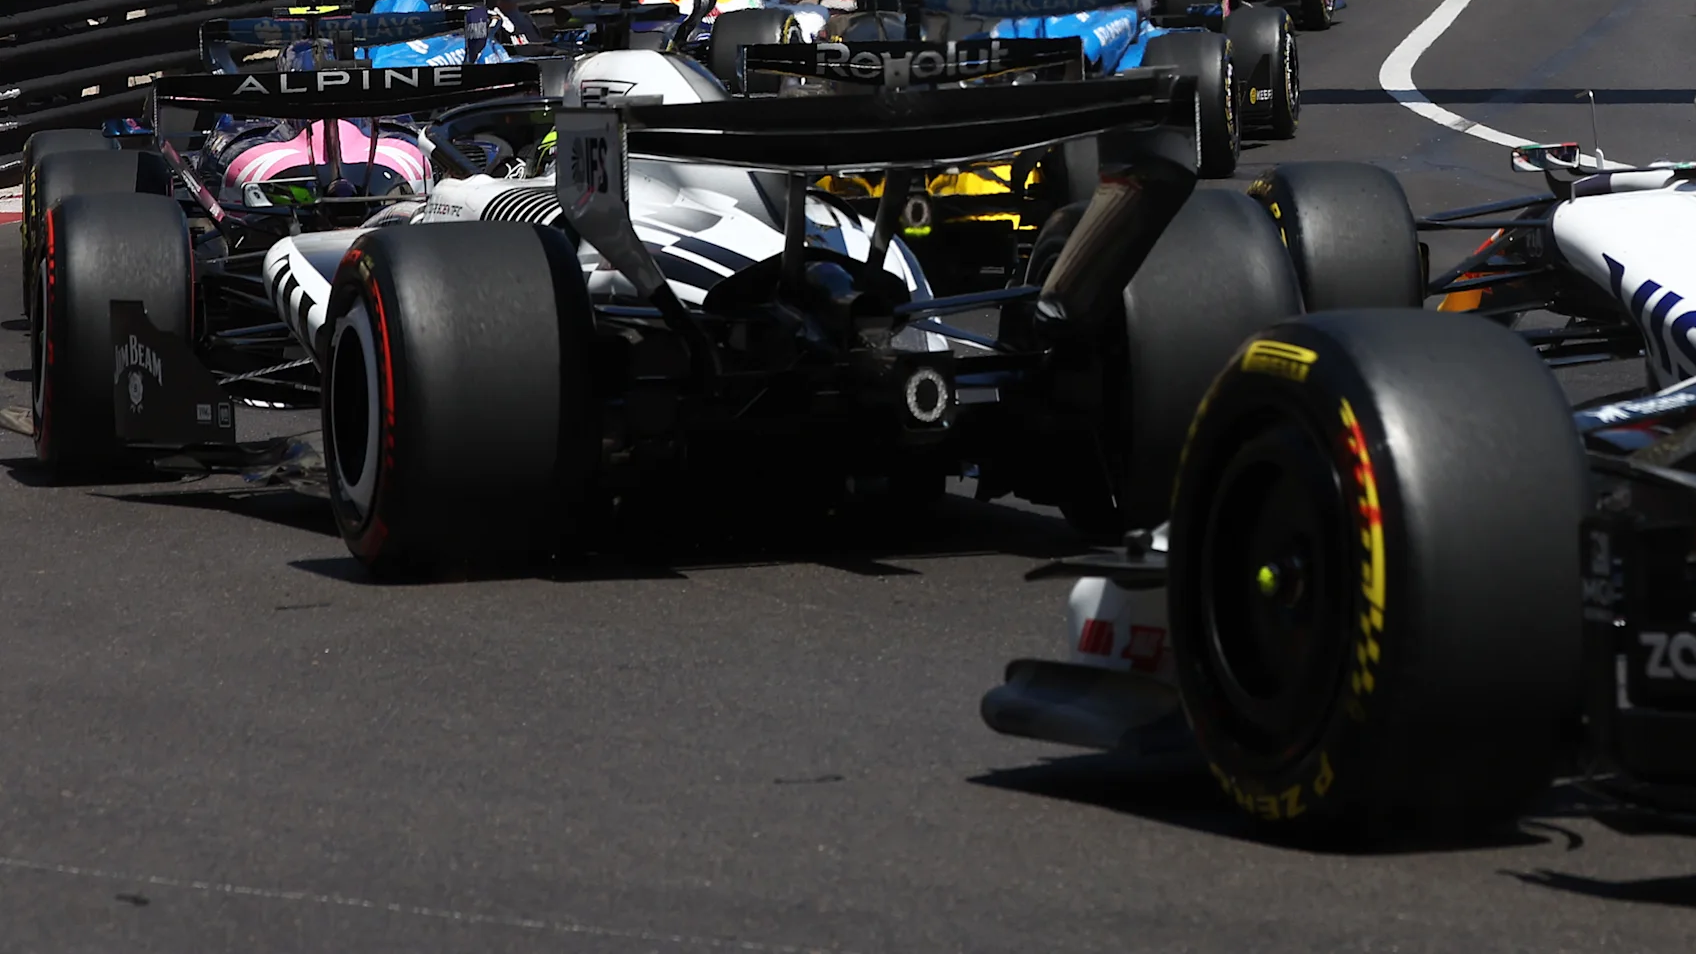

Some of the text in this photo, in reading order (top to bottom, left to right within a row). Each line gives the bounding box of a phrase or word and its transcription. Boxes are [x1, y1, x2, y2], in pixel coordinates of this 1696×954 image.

[816, 41, 1009, 78] Reolut
[232, 66, 463, 96] ALPINE
[114, 334, 163, 387] JIM BEAM
